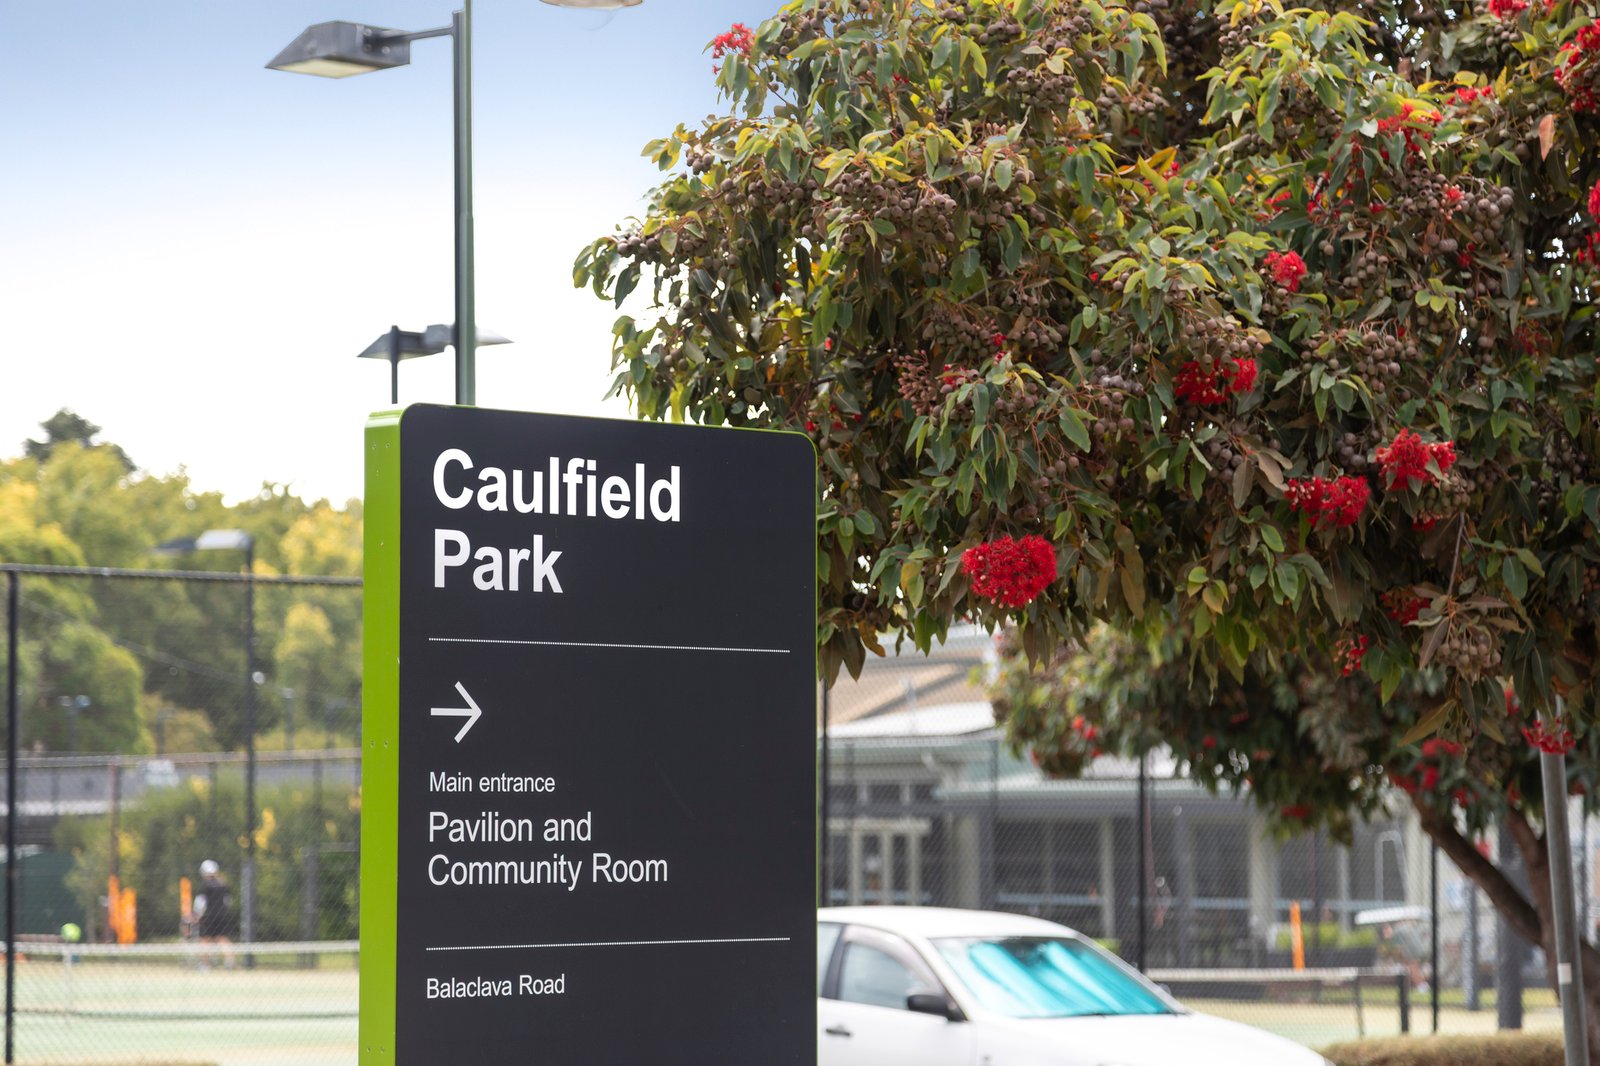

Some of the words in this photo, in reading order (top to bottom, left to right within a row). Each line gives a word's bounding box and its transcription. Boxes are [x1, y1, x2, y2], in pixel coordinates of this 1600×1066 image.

[433, 448, 680, 522] Caulfield
[435, 529, 563, 593] Park
[430, 772, 472, 792] Main
[479, 773, 555, 792] entrance
[430, 812, 532, 842] Pavilion
[544, 811, 591, 841] and
[428, 853, 582, 891] Community
[593, 853, 667, 882] Room
[427, 977, 512, 999] Balaclava
[520, 973, 564, 995] Road
